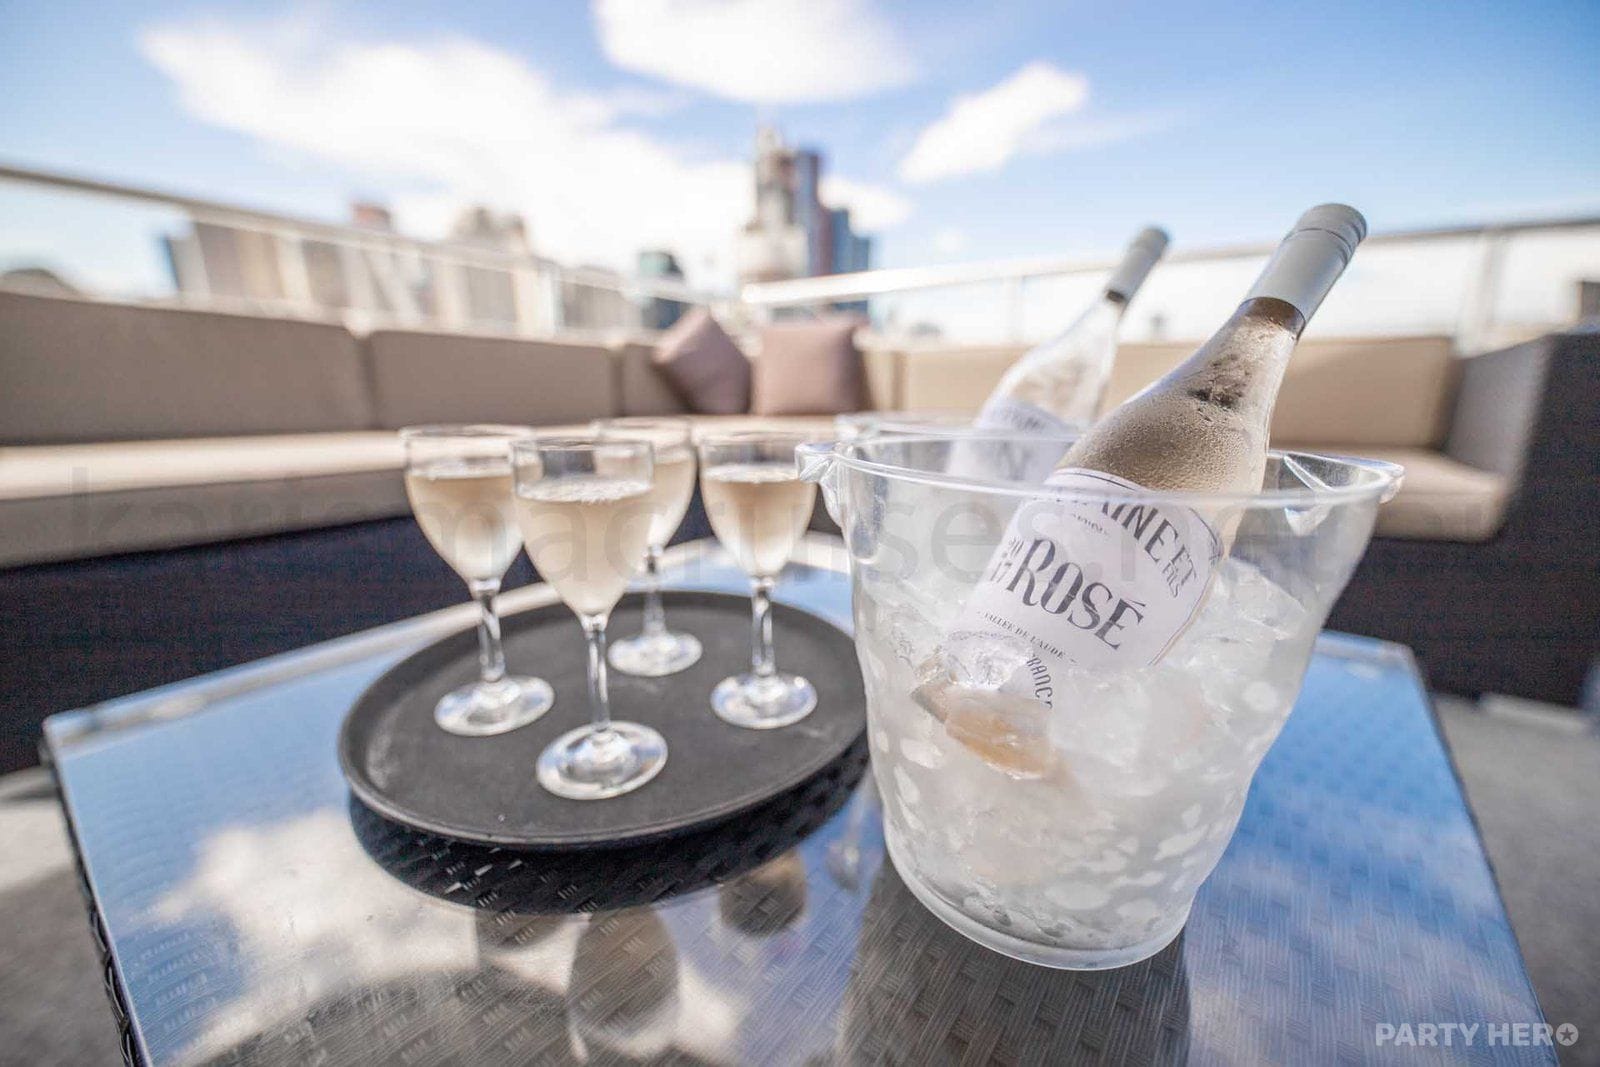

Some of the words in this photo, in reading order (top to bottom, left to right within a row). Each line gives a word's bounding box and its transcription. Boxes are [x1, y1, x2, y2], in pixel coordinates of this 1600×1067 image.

[989, 561, 1013, 585] 17
[1006, 538, 1146, 650] ROSÉ
[1014, 627, 1030, 638] DE
[1026, 654, 1054, 709] RANC
